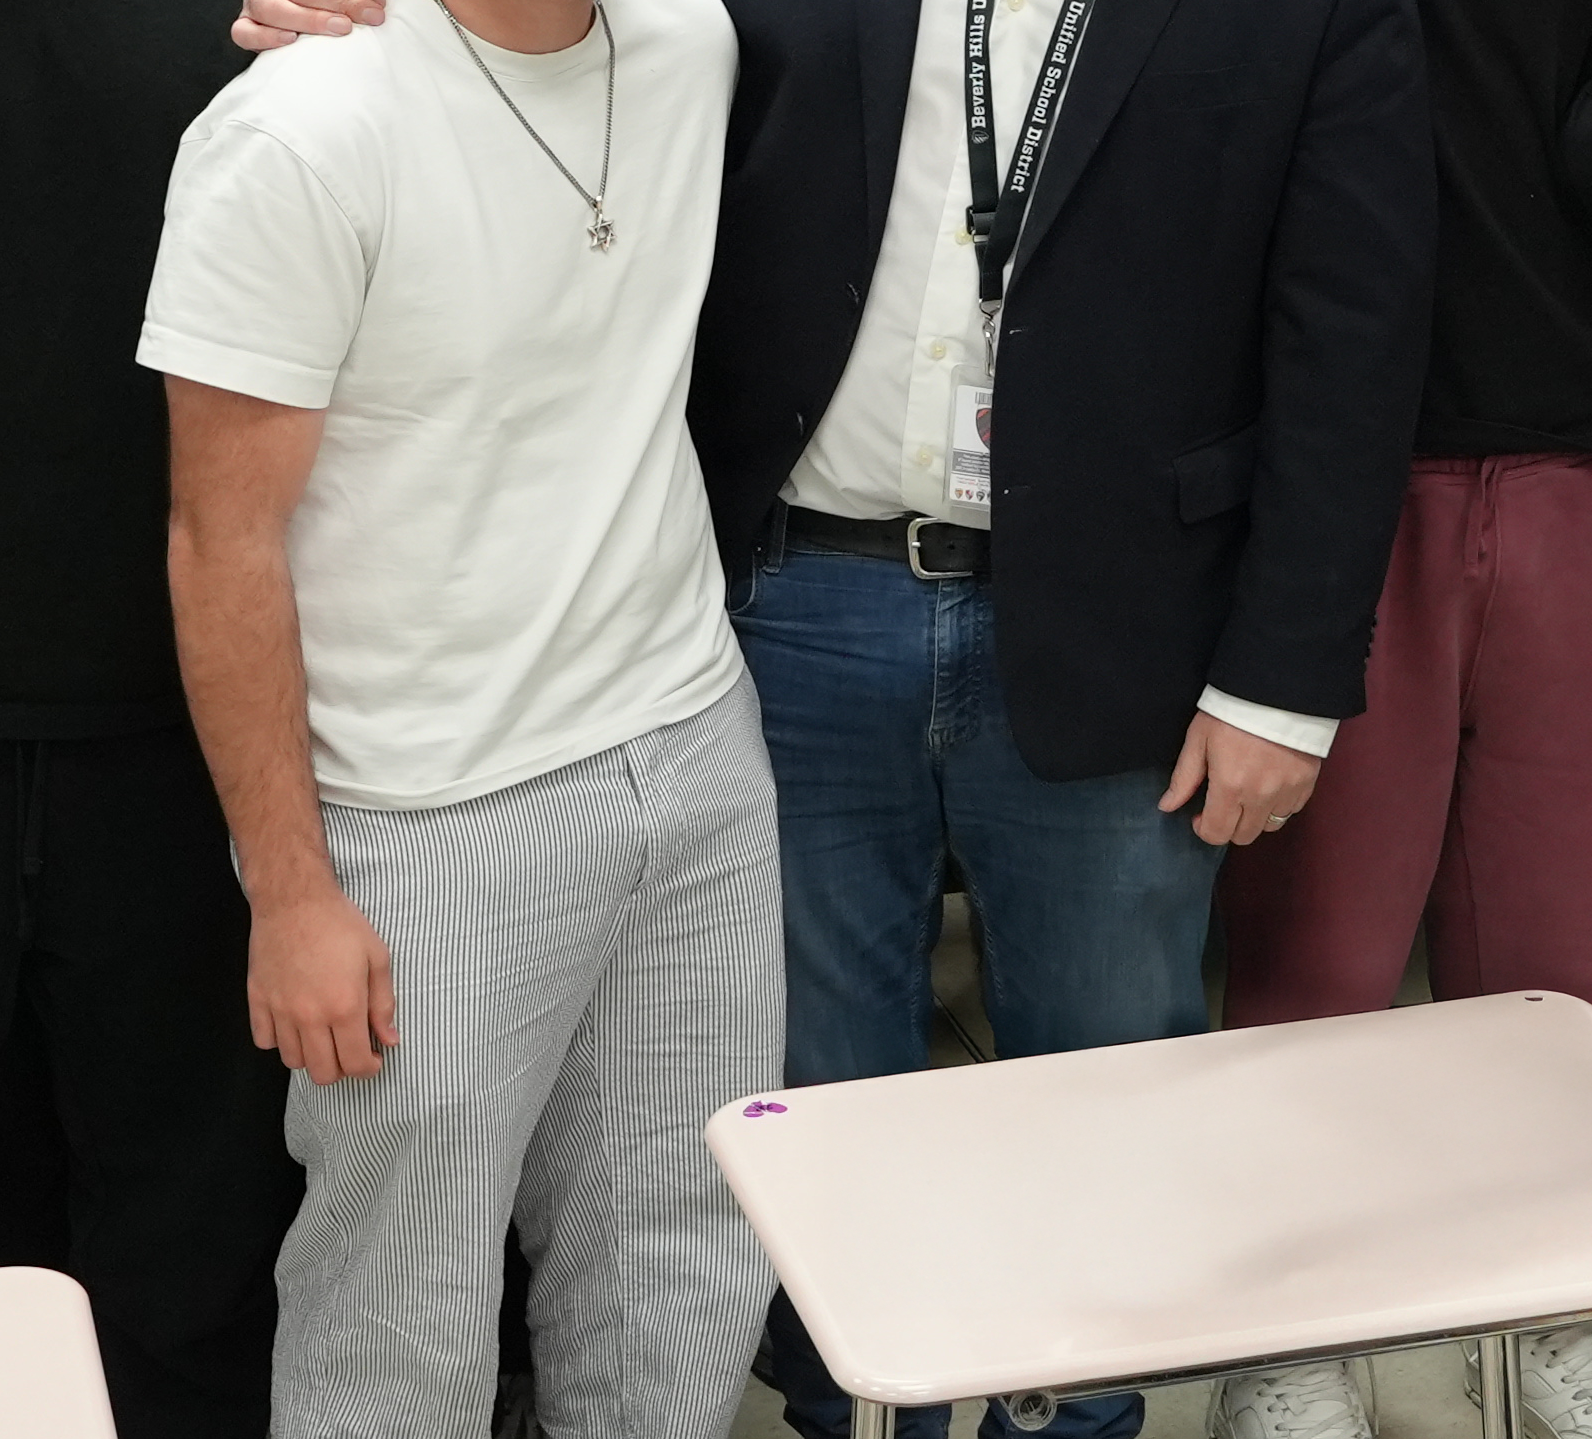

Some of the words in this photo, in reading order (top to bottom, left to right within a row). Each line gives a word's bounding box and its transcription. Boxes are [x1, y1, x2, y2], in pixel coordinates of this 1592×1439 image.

[969, 15, 986, 58] Hills
[1051, 1, 1086, 64] Unified
[969, 62, 986, 129] Beverly
[1032, 66, 1062, 125] School
[1011, 126, 1044, 193] District
